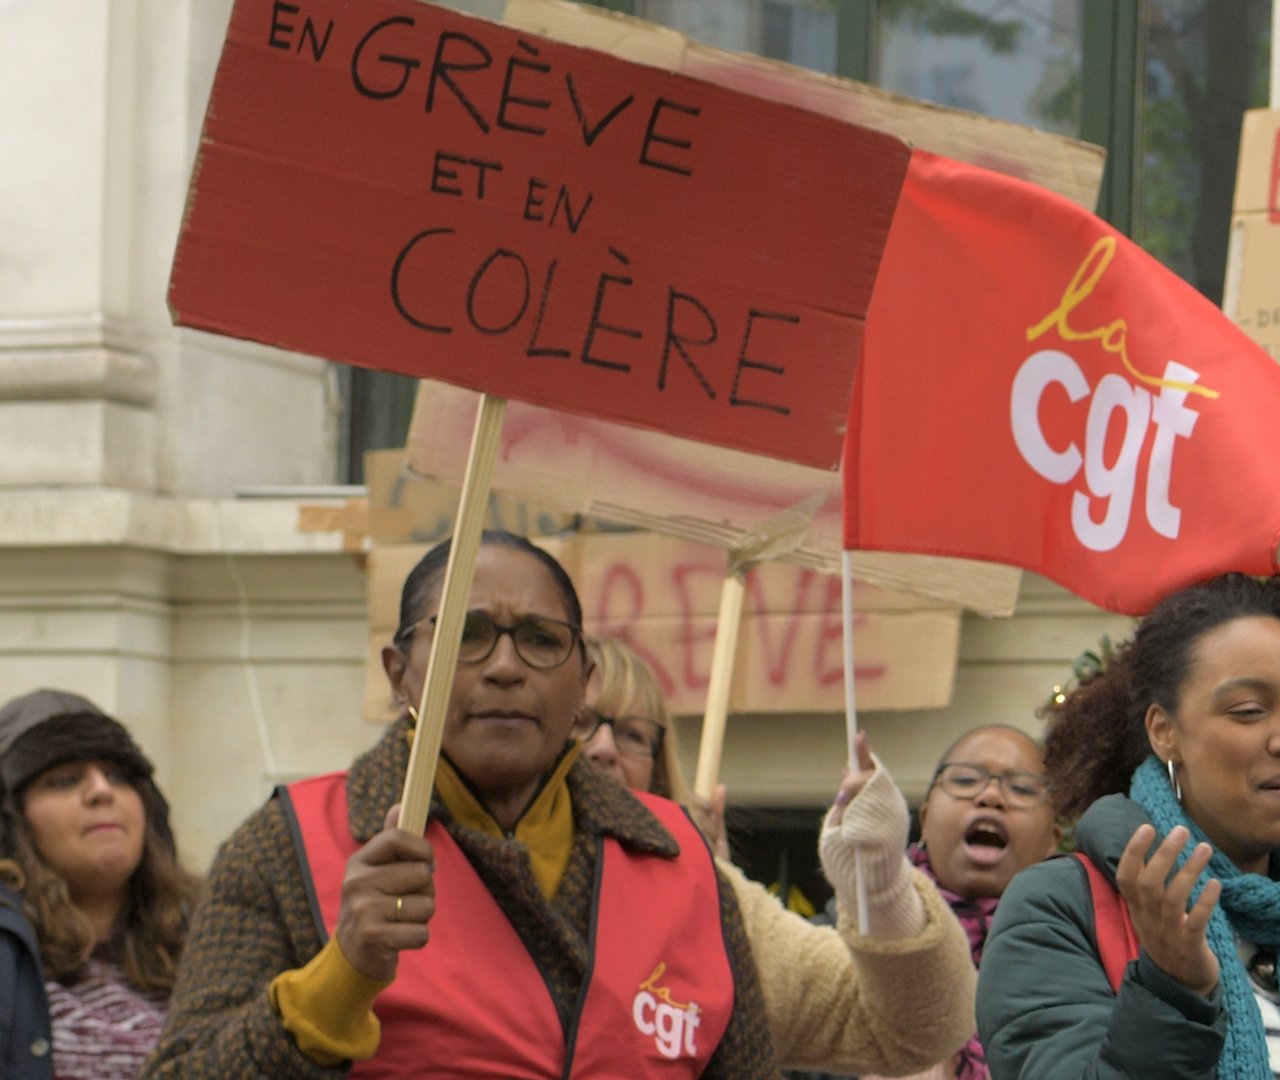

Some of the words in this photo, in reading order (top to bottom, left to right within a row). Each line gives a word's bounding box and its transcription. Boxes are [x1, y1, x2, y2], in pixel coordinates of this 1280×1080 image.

[268, 0, 333, 61] EN
[352, 16, 700, 176] GRÈVE
[431, 151, 503, 199] ET
[523, 177, 593, 234] EN
[390, 228, 801, 415] COLÈRE
[1010, 349, 1200, 552] cgt
[632, 990, 702, 1059] cgt
